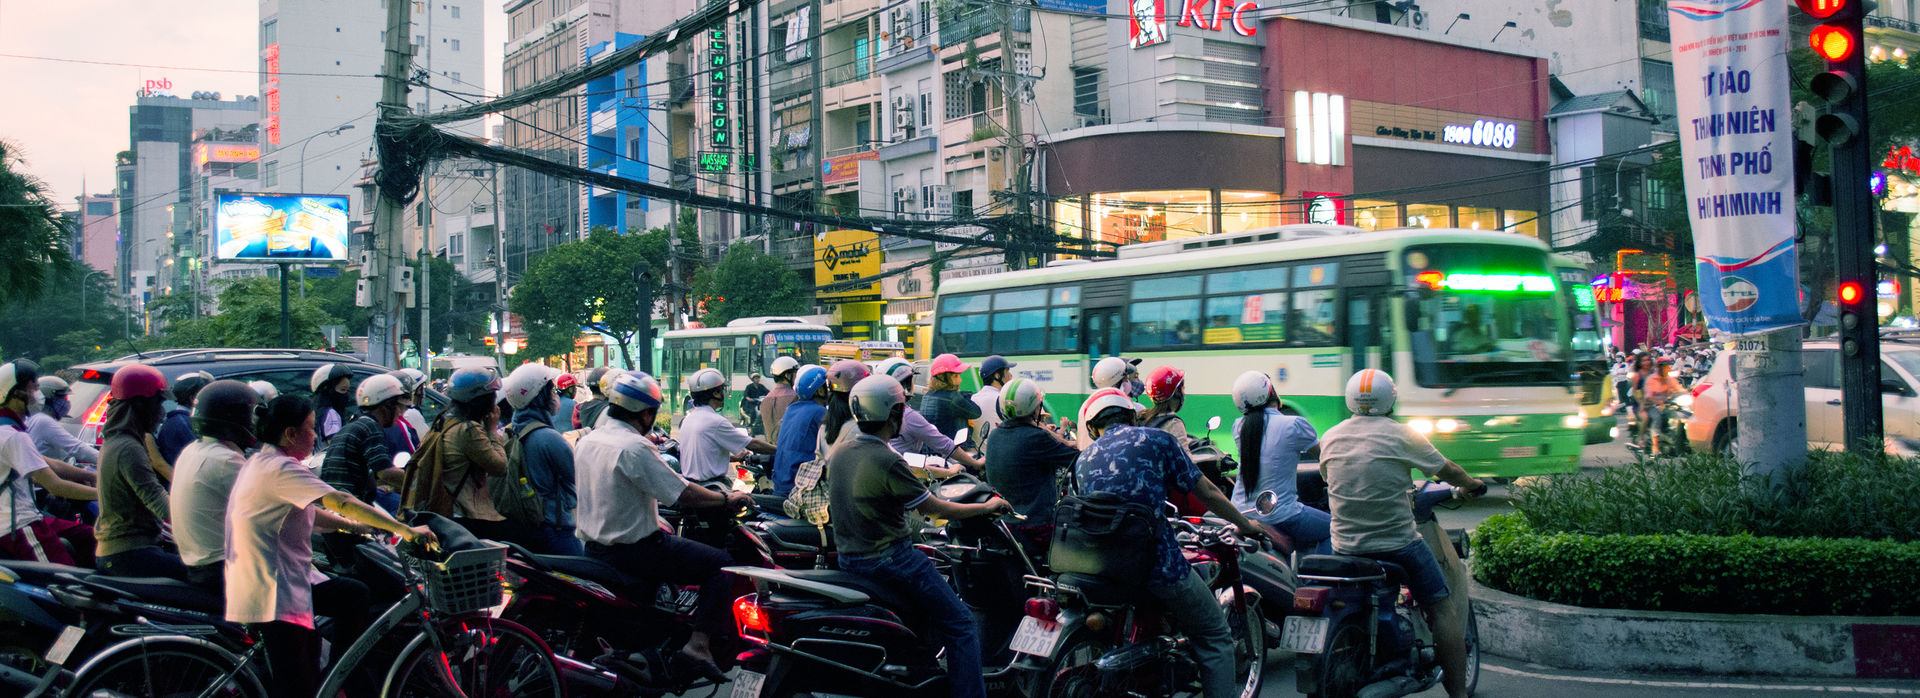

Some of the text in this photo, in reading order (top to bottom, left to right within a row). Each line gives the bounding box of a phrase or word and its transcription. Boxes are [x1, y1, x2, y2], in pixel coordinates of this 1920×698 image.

[1178, 0, 1257, 36] KFC
[146, 77, 173, 93] psb
[1727, 105, 1775, 135] NIÊN
[701, 153, 728, 166] MASSAGE
[1730, 142, 1772, 175] PHỐ
[1729, 191, 1782, 217] MINH
[818, 625, 871, 637] LEAD
